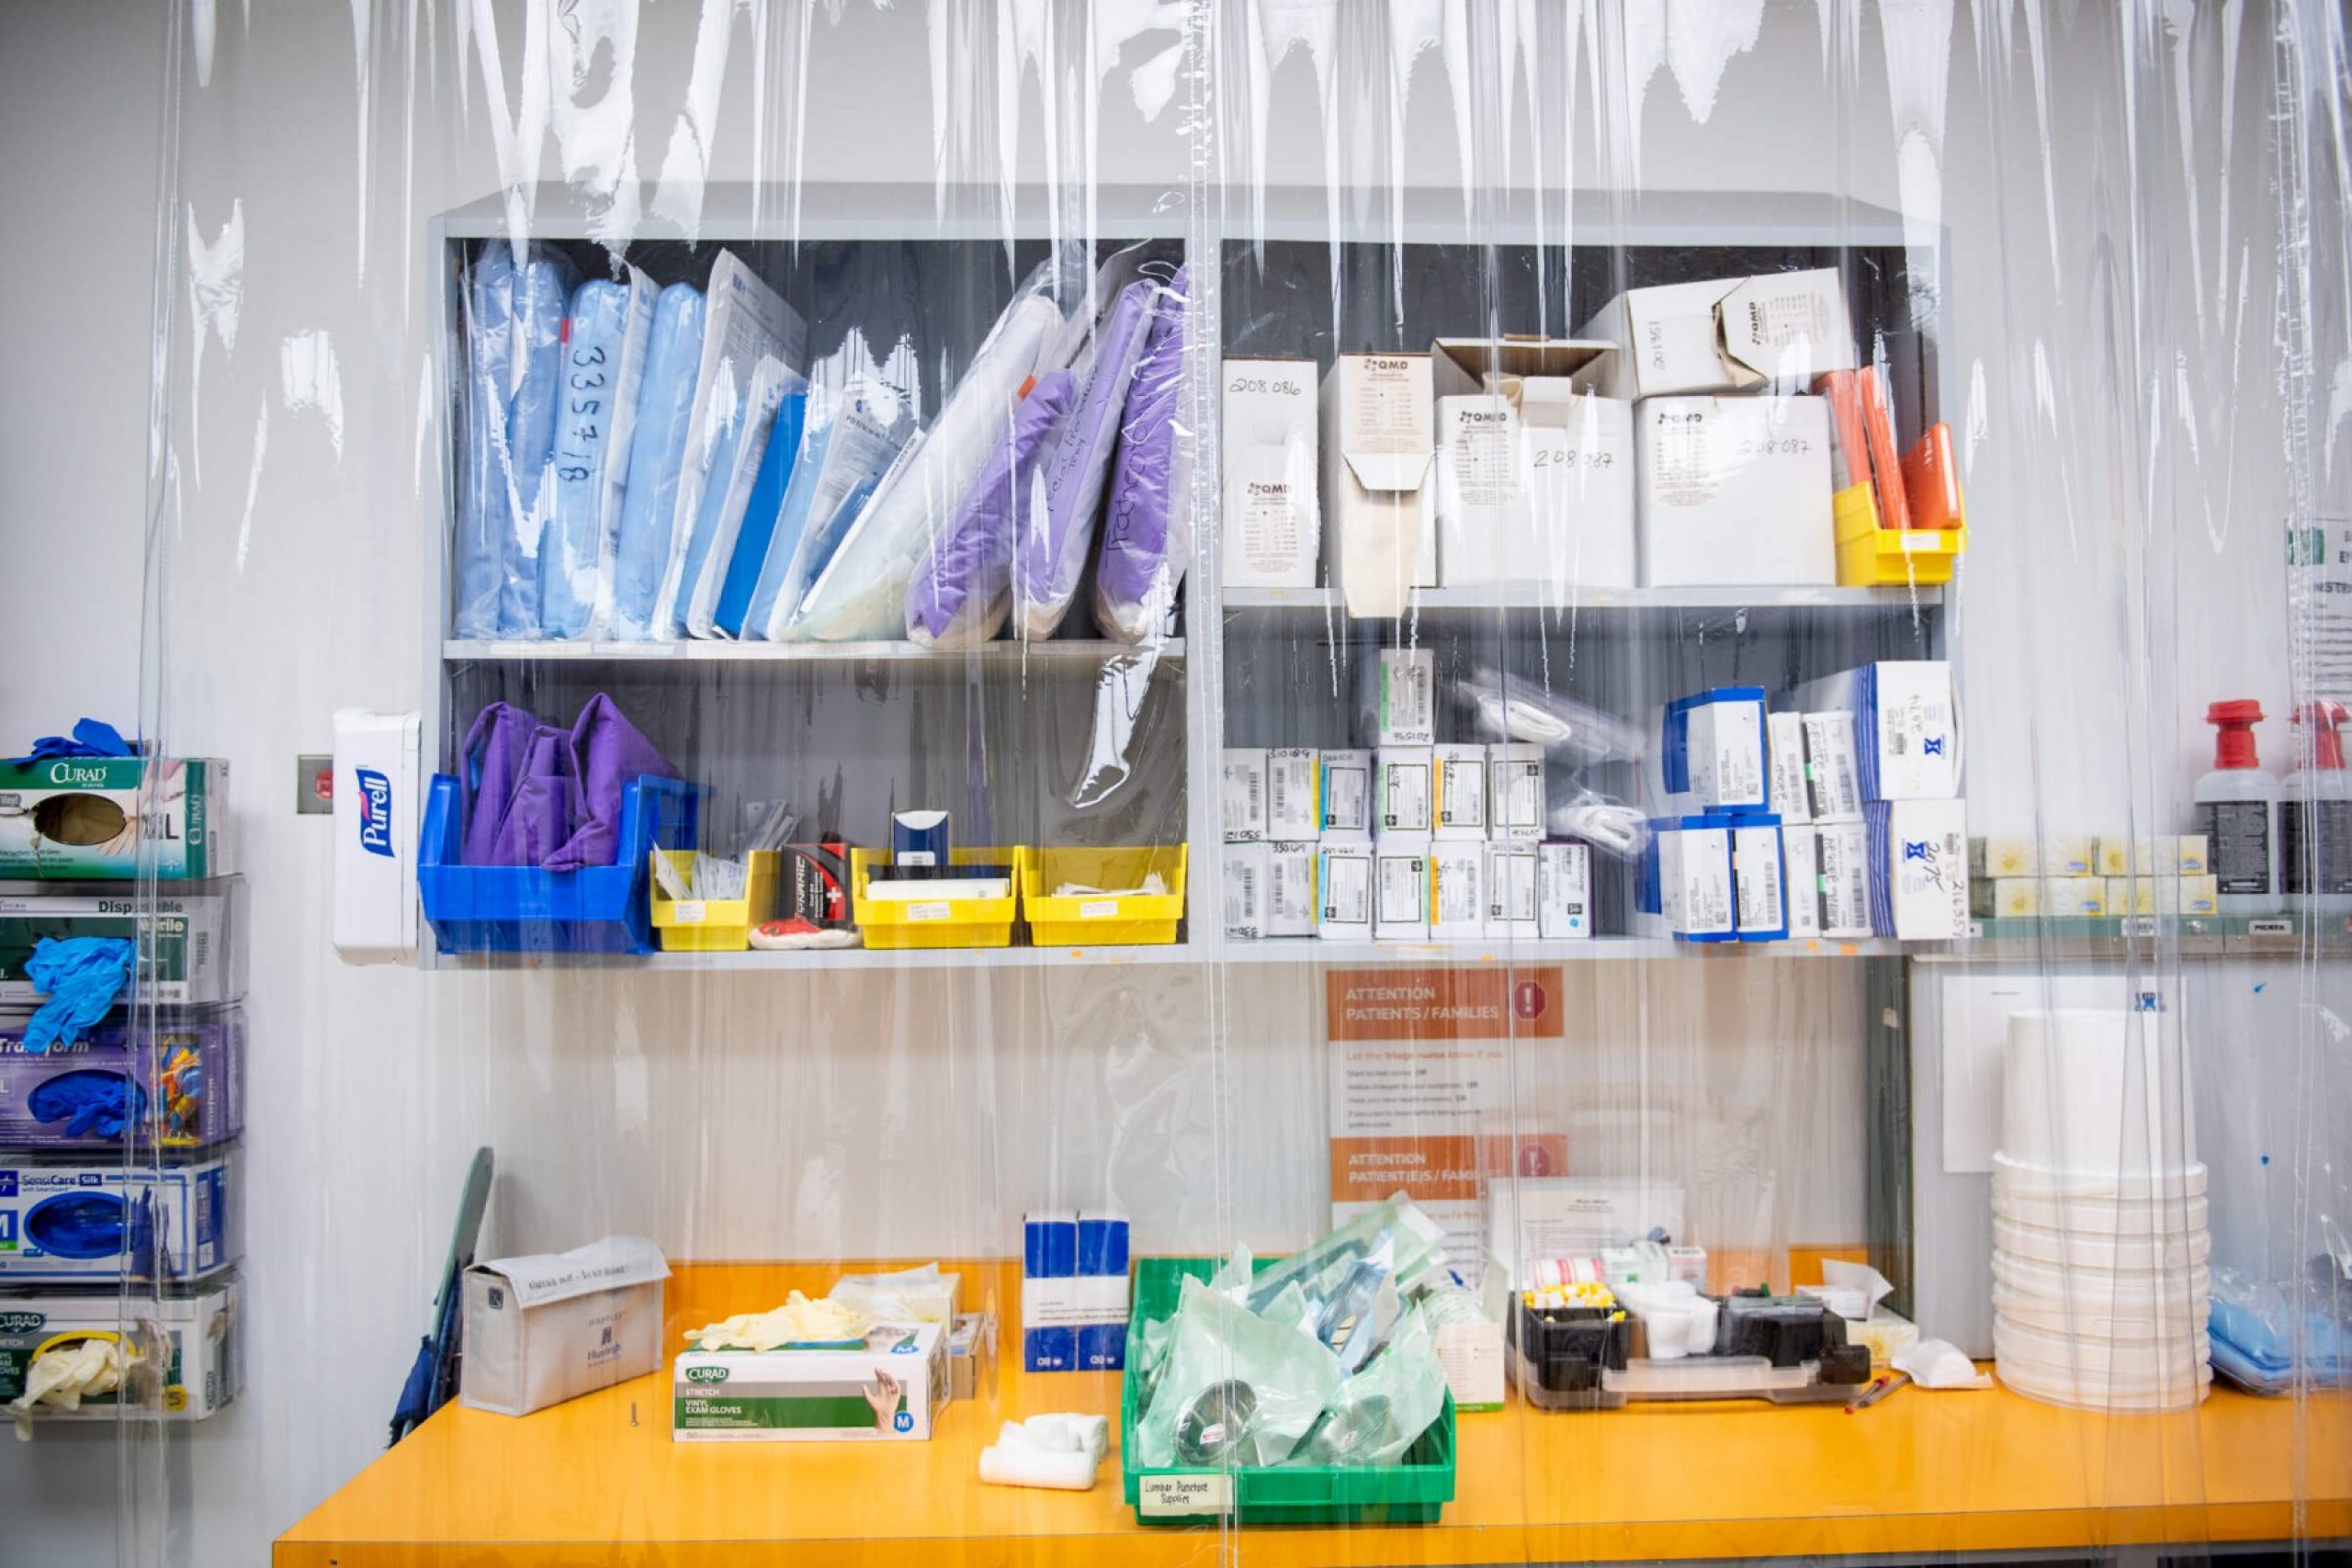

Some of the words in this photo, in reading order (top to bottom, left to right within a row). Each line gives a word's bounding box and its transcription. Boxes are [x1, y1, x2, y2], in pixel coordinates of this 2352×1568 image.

[1377, 361, 1408, 370] QMD
[1229, 378, 1267, 394] 208
[1272, 378, 1301, 395] 086
[50, 763, 107, 784] CURAD
[362, 775, 389, 846] Purell
[1346, 987, 1436, 1001] ATTENTION
[1346, 1007, 1421, 1021] PATIENTS
[1431, 1006, 1499, 1020] FAMILIES
[1349, 1153, 1427, 1166] ATTENTION
[22, 1174, 75, 1186] SensiCare
[688, 1369, 727, 1380] CURAD
[685, 1388, 719, 1396] STRETCH
[685, 1406, 709, 1415] EXAM
[709, 1406, 741, 1415] GLOVES
[897, 1416, 910, 1427] M
